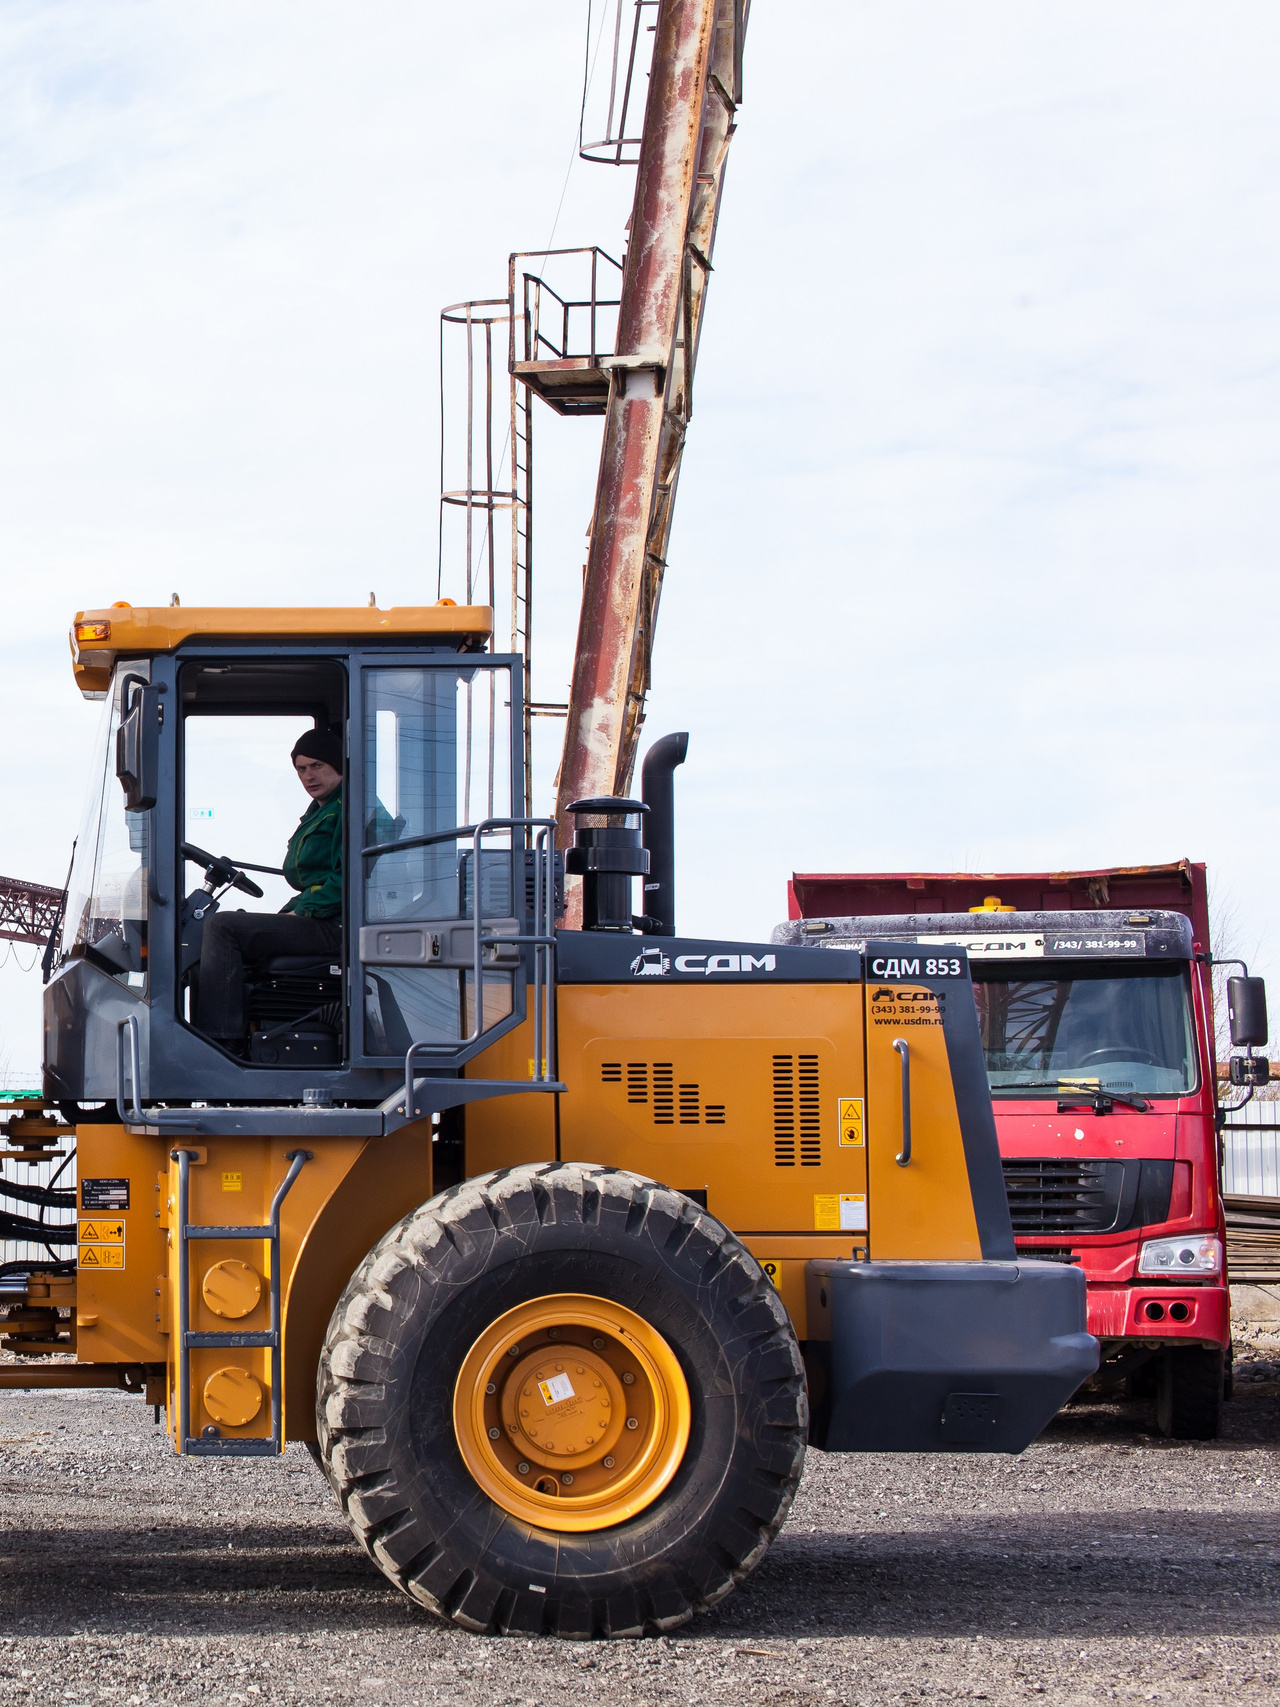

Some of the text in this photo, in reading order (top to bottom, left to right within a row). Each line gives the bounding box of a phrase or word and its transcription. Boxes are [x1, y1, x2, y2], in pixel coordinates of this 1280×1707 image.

[1085, 940, 1137, 949] 381-99-99
[872, 958, 961, 978] СДМ 853
[871, 1005, 946, 1015] (343) 381-99-99
[874, 1016, 945, 1025] www.usdm.ru
